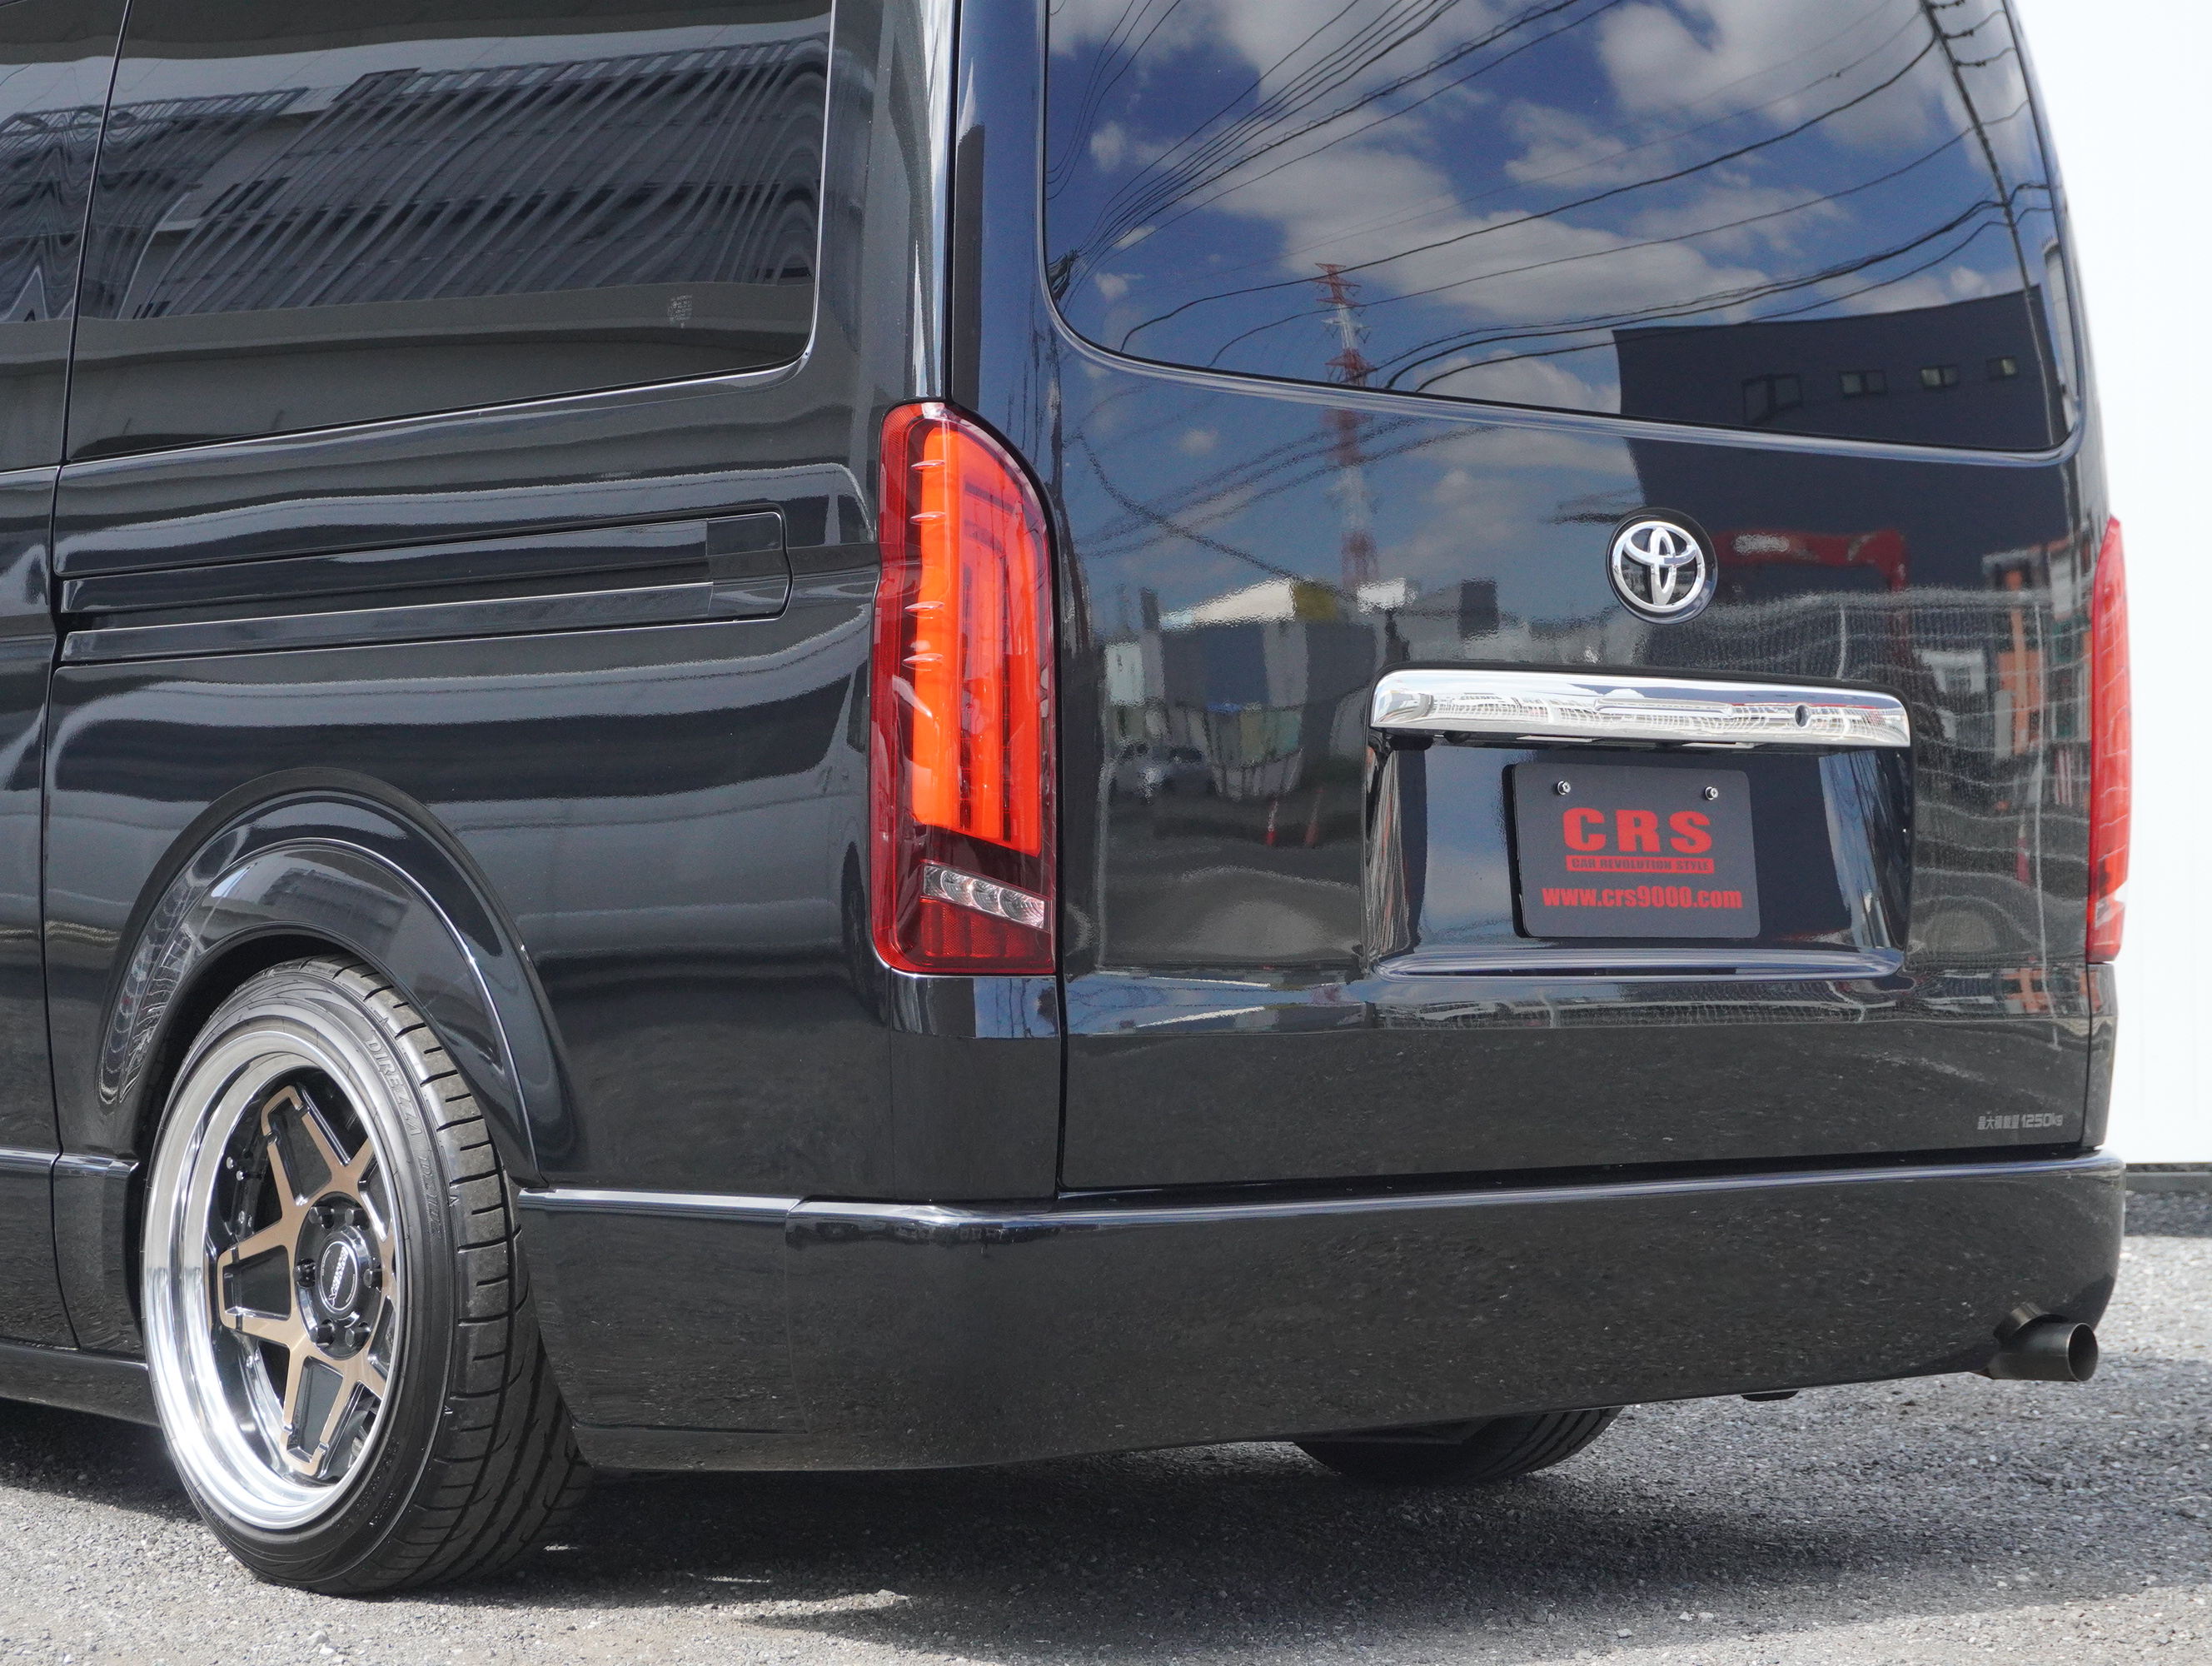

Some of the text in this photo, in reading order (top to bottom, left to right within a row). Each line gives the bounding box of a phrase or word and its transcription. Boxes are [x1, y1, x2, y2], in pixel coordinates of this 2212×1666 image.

[1562, 807, 1712, 854] CRS
[1572, 858, 1709, 871] CAR REVOLUTION STYLE
[1542, 885, 1743, 909] www.crs9000.com
[366, 1035, 422, 1136] DIREZZA
[2021, 1112, 2064, 1128] 1250kg
